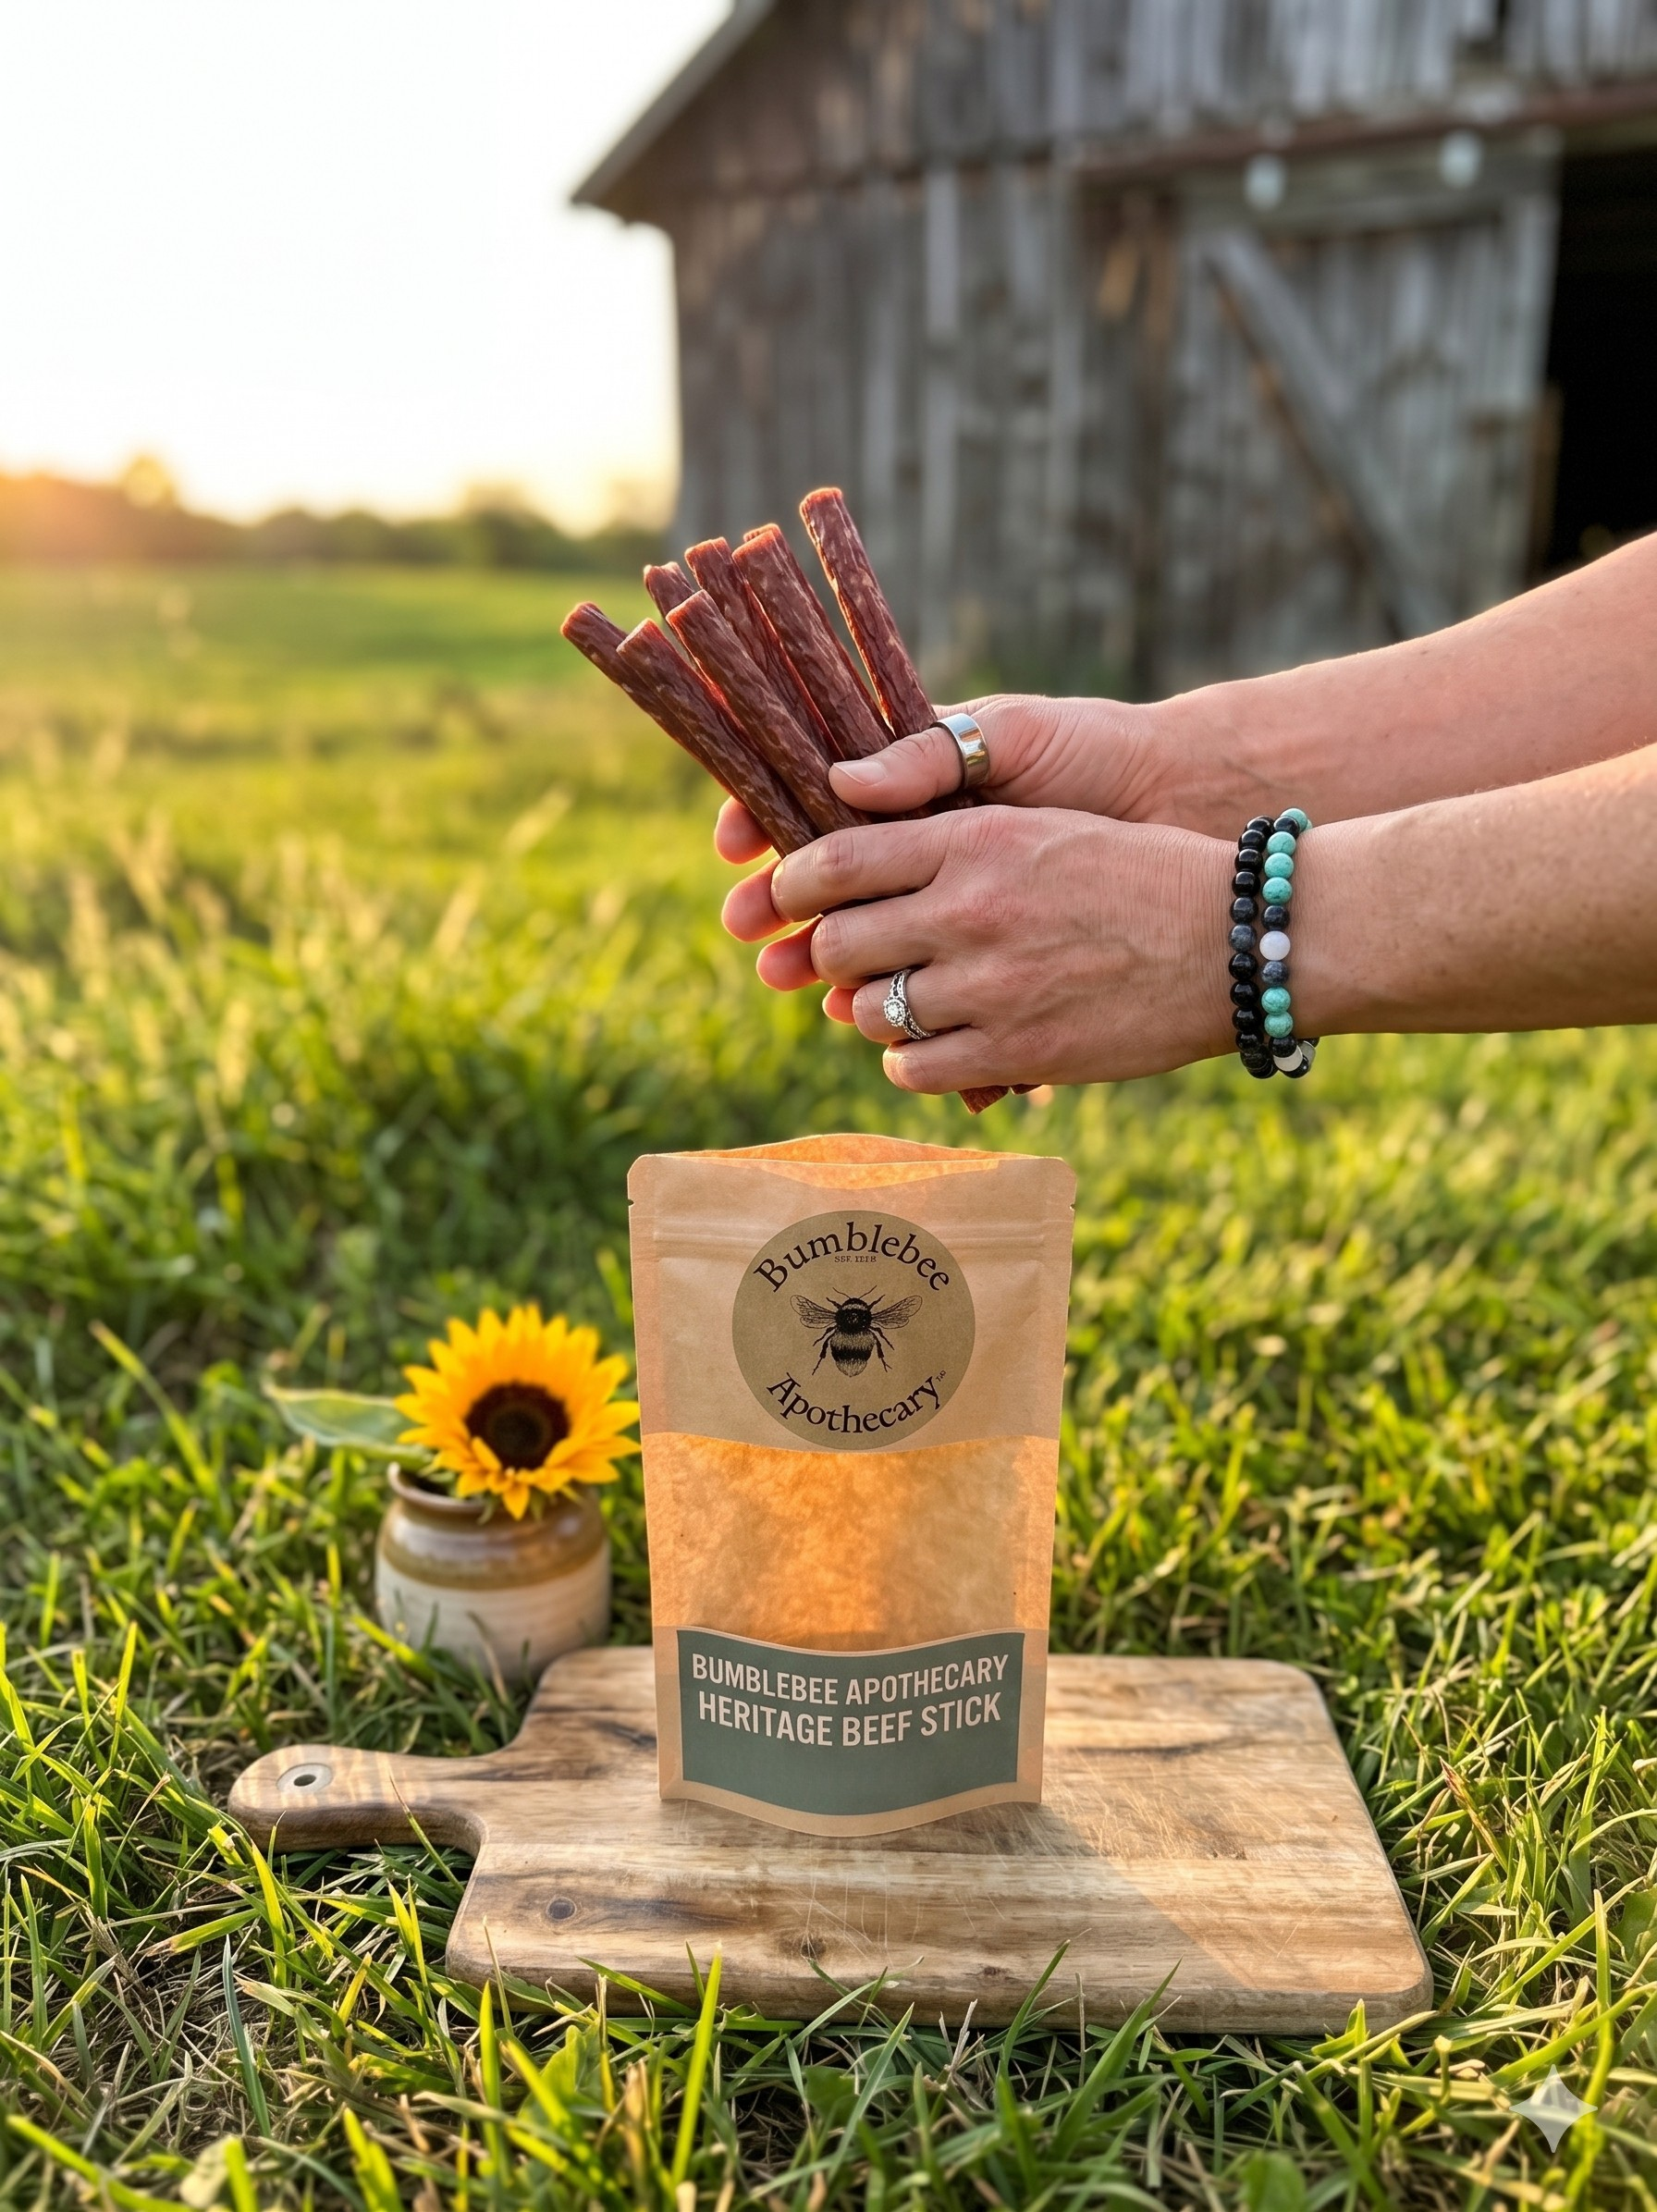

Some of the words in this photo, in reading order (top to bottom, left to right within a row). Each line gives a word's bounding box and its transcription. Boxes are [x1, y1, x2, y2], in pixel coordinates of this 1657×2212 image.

[753, 1222, 950, 1292] Bumblebee
[767, 1372, 940, 1433] Apothecary
[692, 1653, 839, 1705] BUMBLEBEE
[845, 1654, 1009, 1705] APOTHECARY
[698, 1691, 832, 1747] HERITAGE
[841, 1710, 913, 1747] BEEF
[919, 1692, 1001, 1737] STICK
